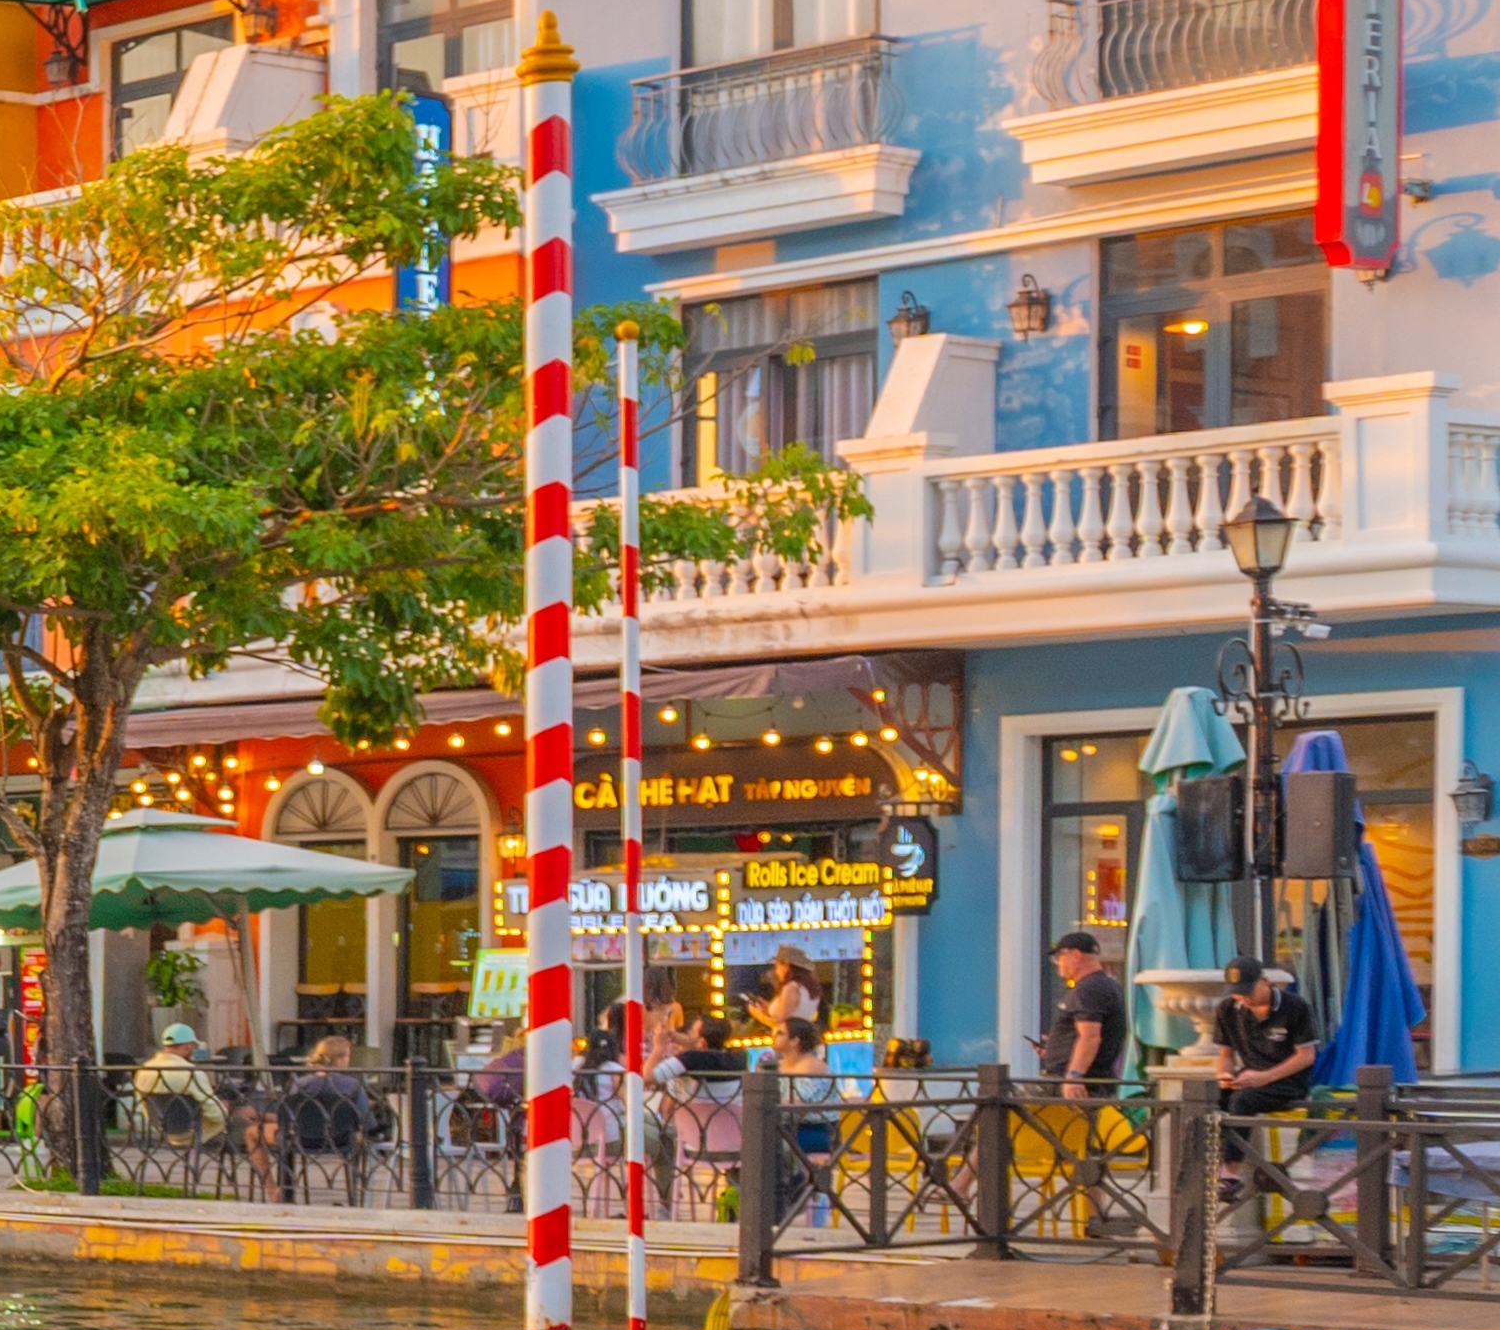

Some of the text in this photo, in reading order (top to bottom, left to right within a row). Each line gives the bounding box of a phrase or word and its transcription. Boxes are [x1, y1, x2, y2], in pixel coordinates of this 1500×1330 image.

[573, 772, 618, 809] CÀ
[619, 772, 674, 807] HÊ
[676, 774, 734, 809] HẠT
[782, 773, 871, 800] NGUYÊN
[745, 858, 880, 888] Rolls Ice Cream
